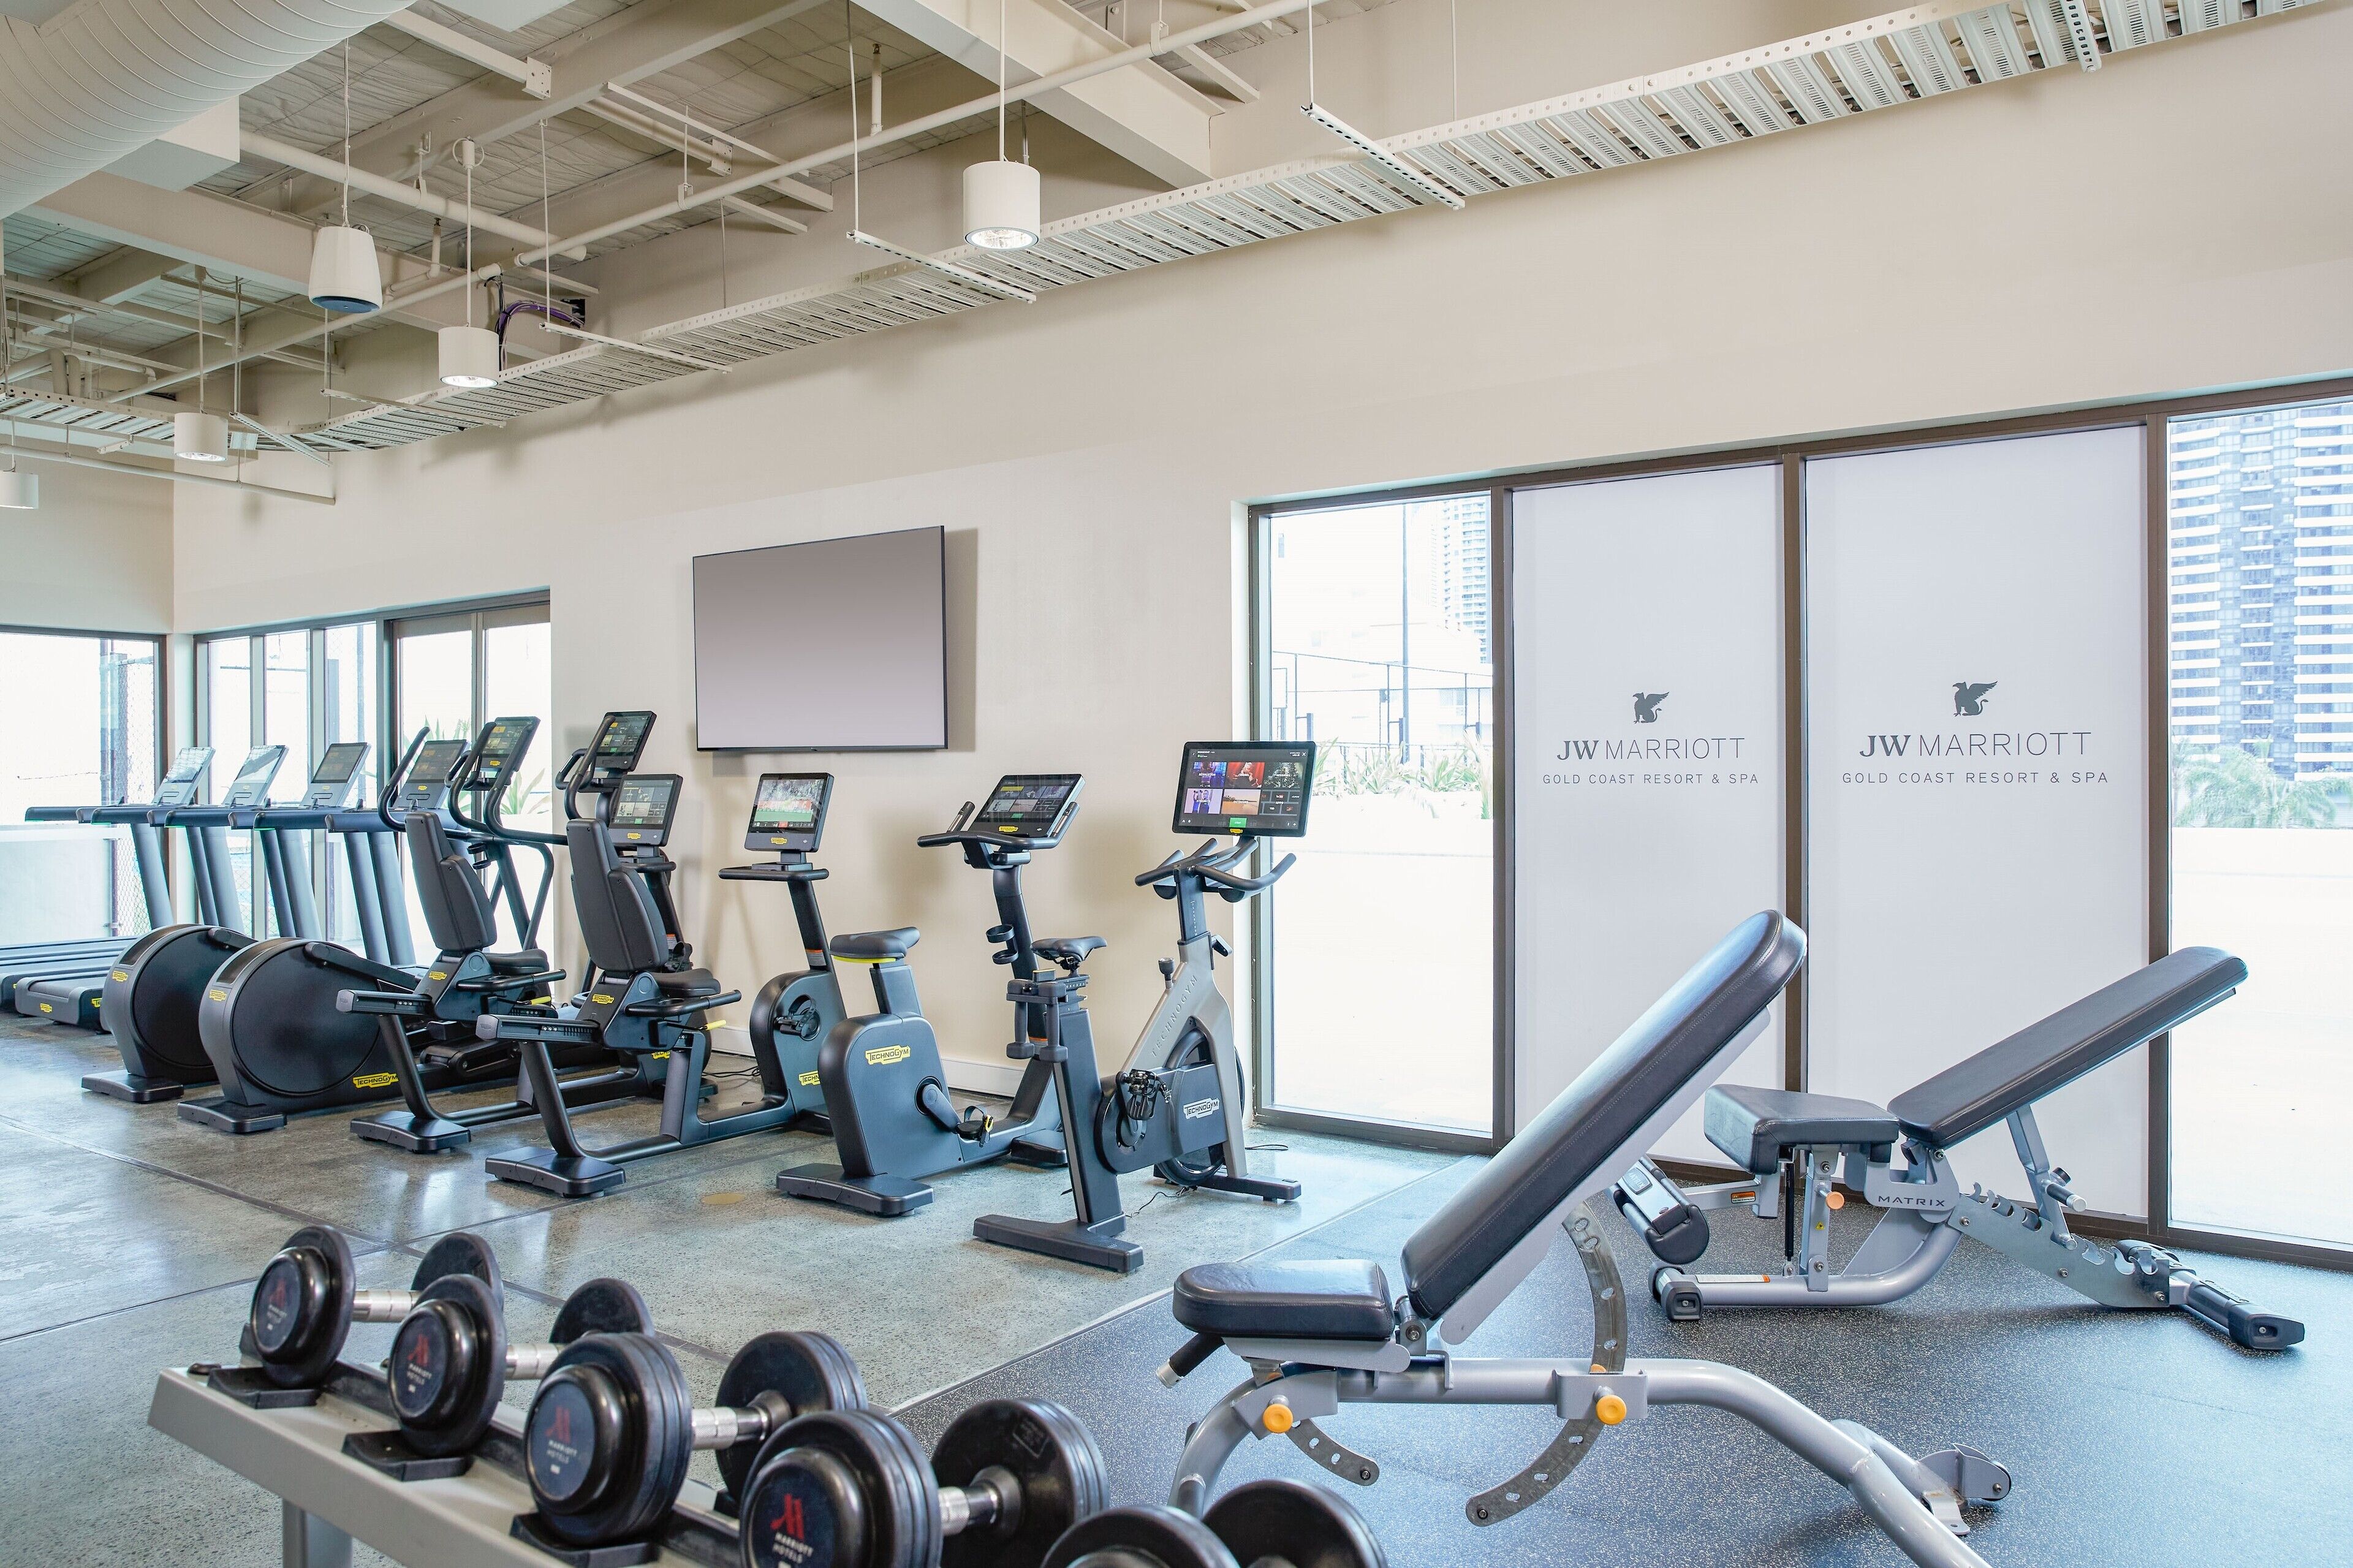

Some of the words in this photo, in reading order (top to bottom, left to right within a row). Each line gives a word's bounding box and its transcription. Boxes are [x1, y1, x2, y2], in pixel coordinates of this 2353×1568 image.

[1557, 740, 1601, 760] JW
[1605, 738, 1745, 760] MARRIOTT
[1859, 735, 1912, 757] JW
[1920, 732, 2092, 757] MARRIOTT
[1542, 774, 1580, 784] GOLD
[1588, 774, 1635, 784] COAST
[1643, 773, 1703, 784] RESORT
[1711, 773, 1720, 784] &
[1729, 773, 1759, 784] SPA
[1842, 772, 1888, 784] GOLD
[1898, 772, 1955, 784] COAST
[1966, 771, 2039, 784] RESORT
[2050, 771, 2060, 784] &
[2071, 771, 2108, 784] SPA
[1151, 975, 1198, 1058] TECHNOGYM
[866, 1047, 909, 1062] TECHNOGYM
[799, 1072, 820, 1083] TECHN
[1183, 1100, 1219, 1116] TECHNOGYM
[1878, 1195, 1946, 1207] MATRIX
[775, 1532, 814, 1557] MARRIOTT
